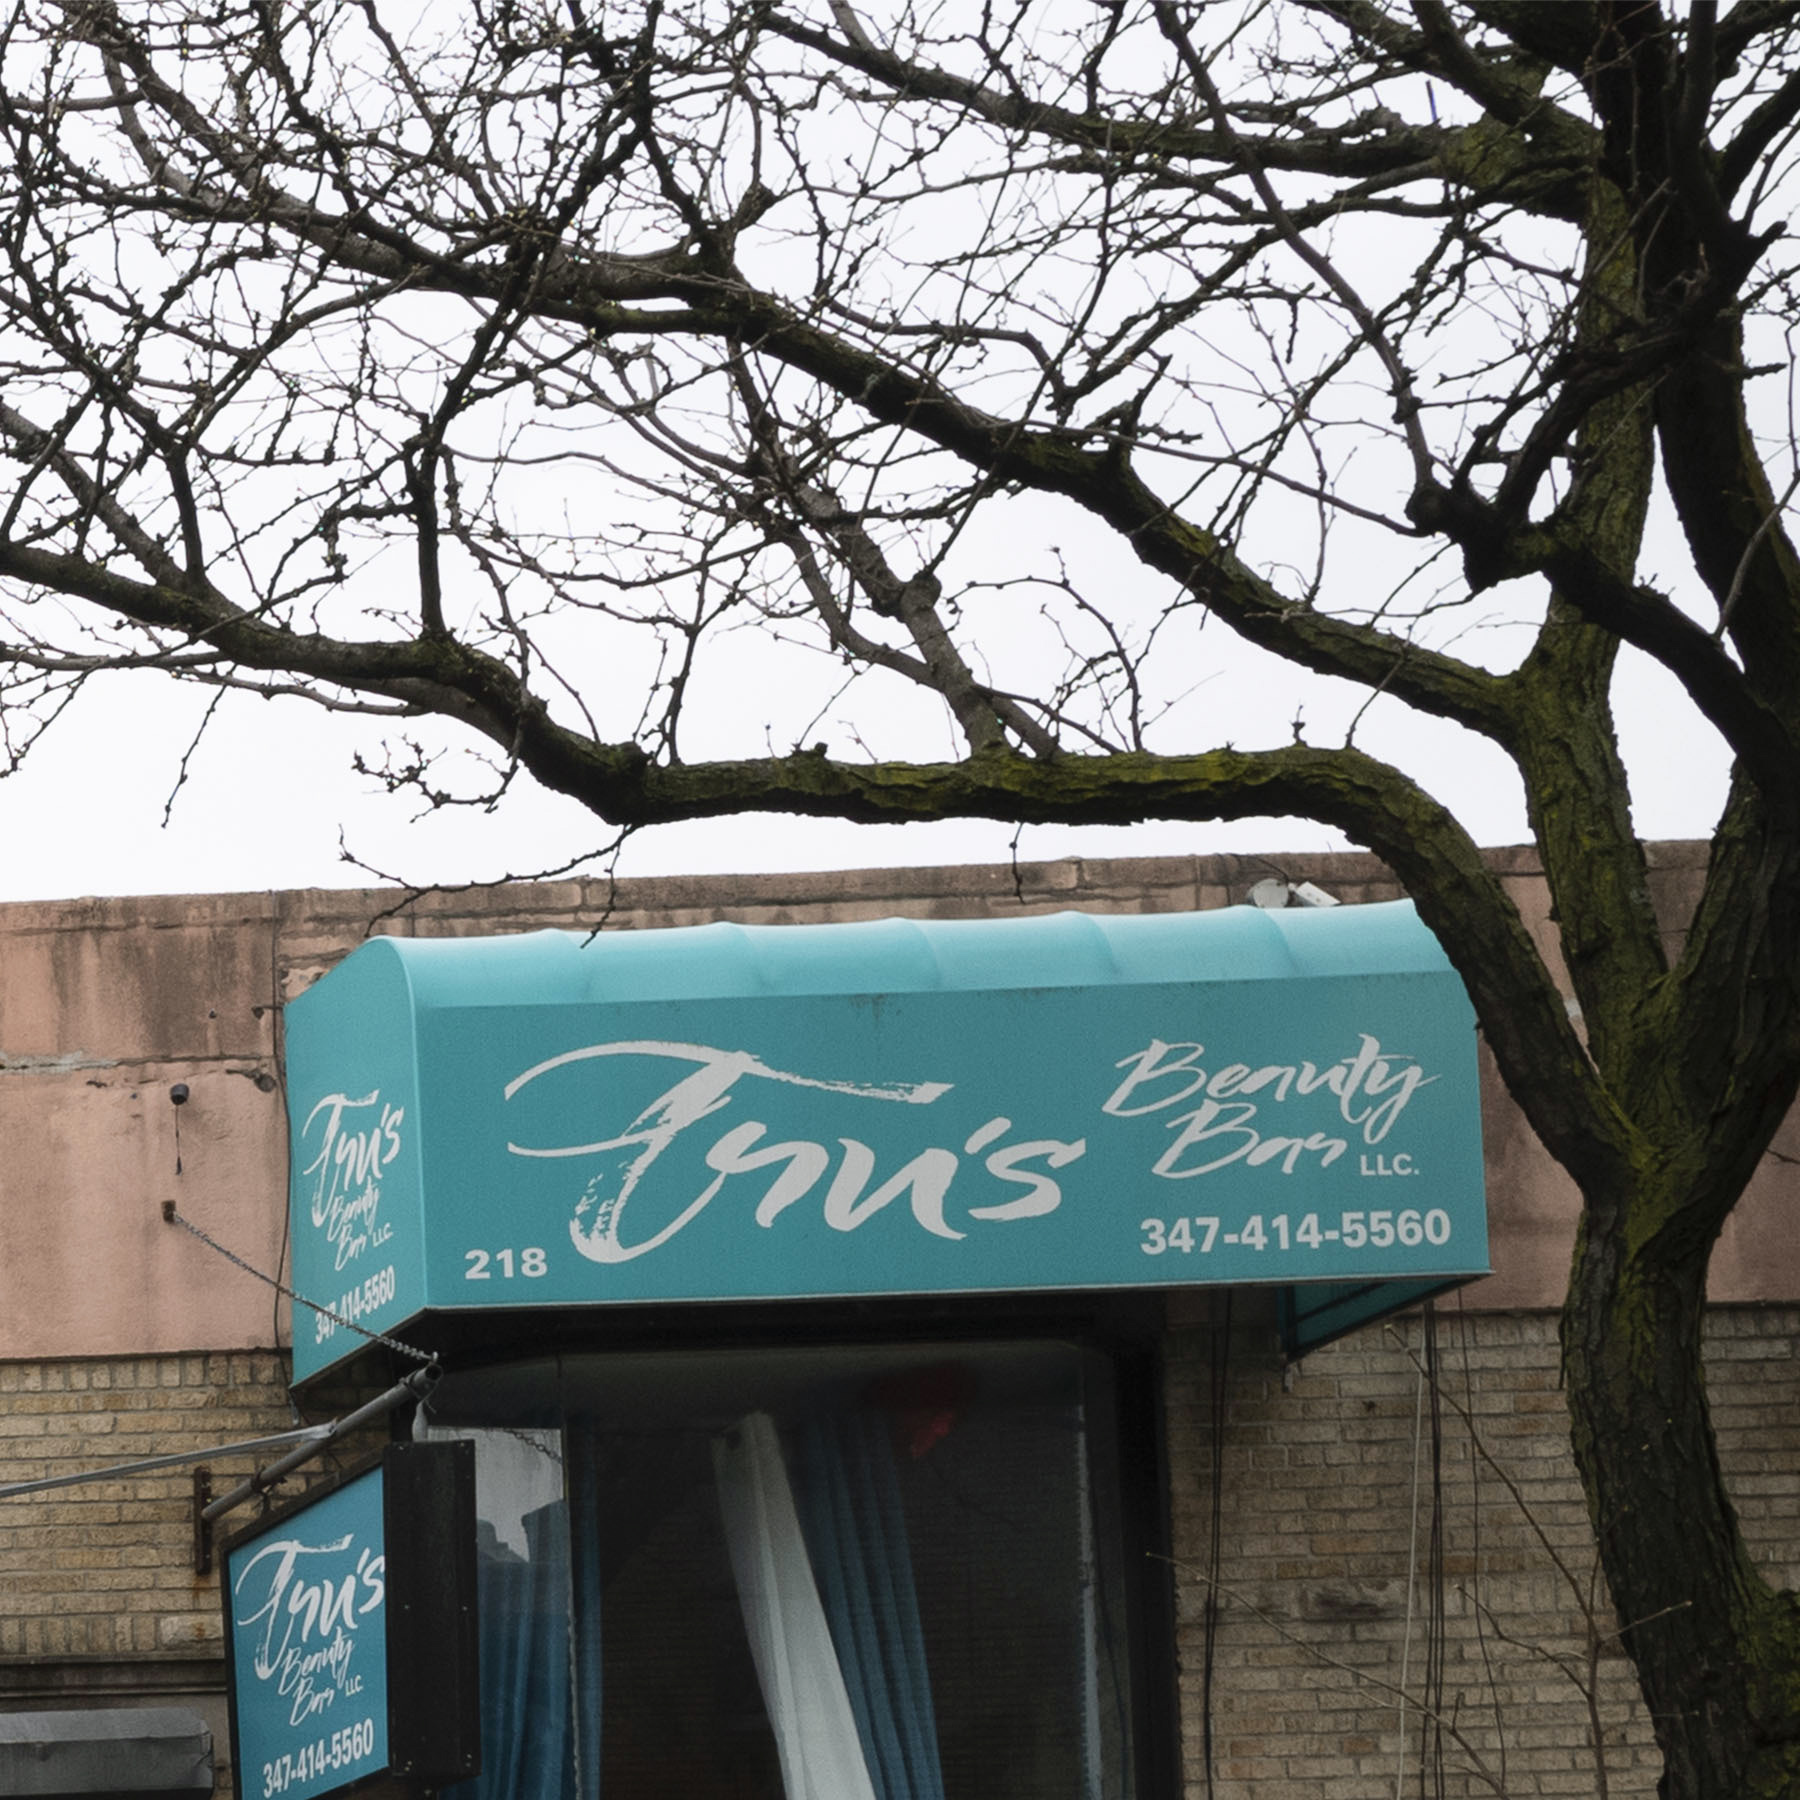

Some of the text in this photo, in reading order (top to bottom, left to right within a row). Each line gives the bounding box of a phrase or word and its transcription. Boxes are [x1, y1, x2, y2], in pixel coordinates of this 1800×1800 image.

[1102, 1033, 1442, 1145] Beauty
[1360, 1154, 1419, 1177] LLC.
[1140, 1209, 1451, 1256] 347-414-5560
[465, 1247, 548, 1280] 218
[263, 1718, 373, 1799] 347-414-5560
